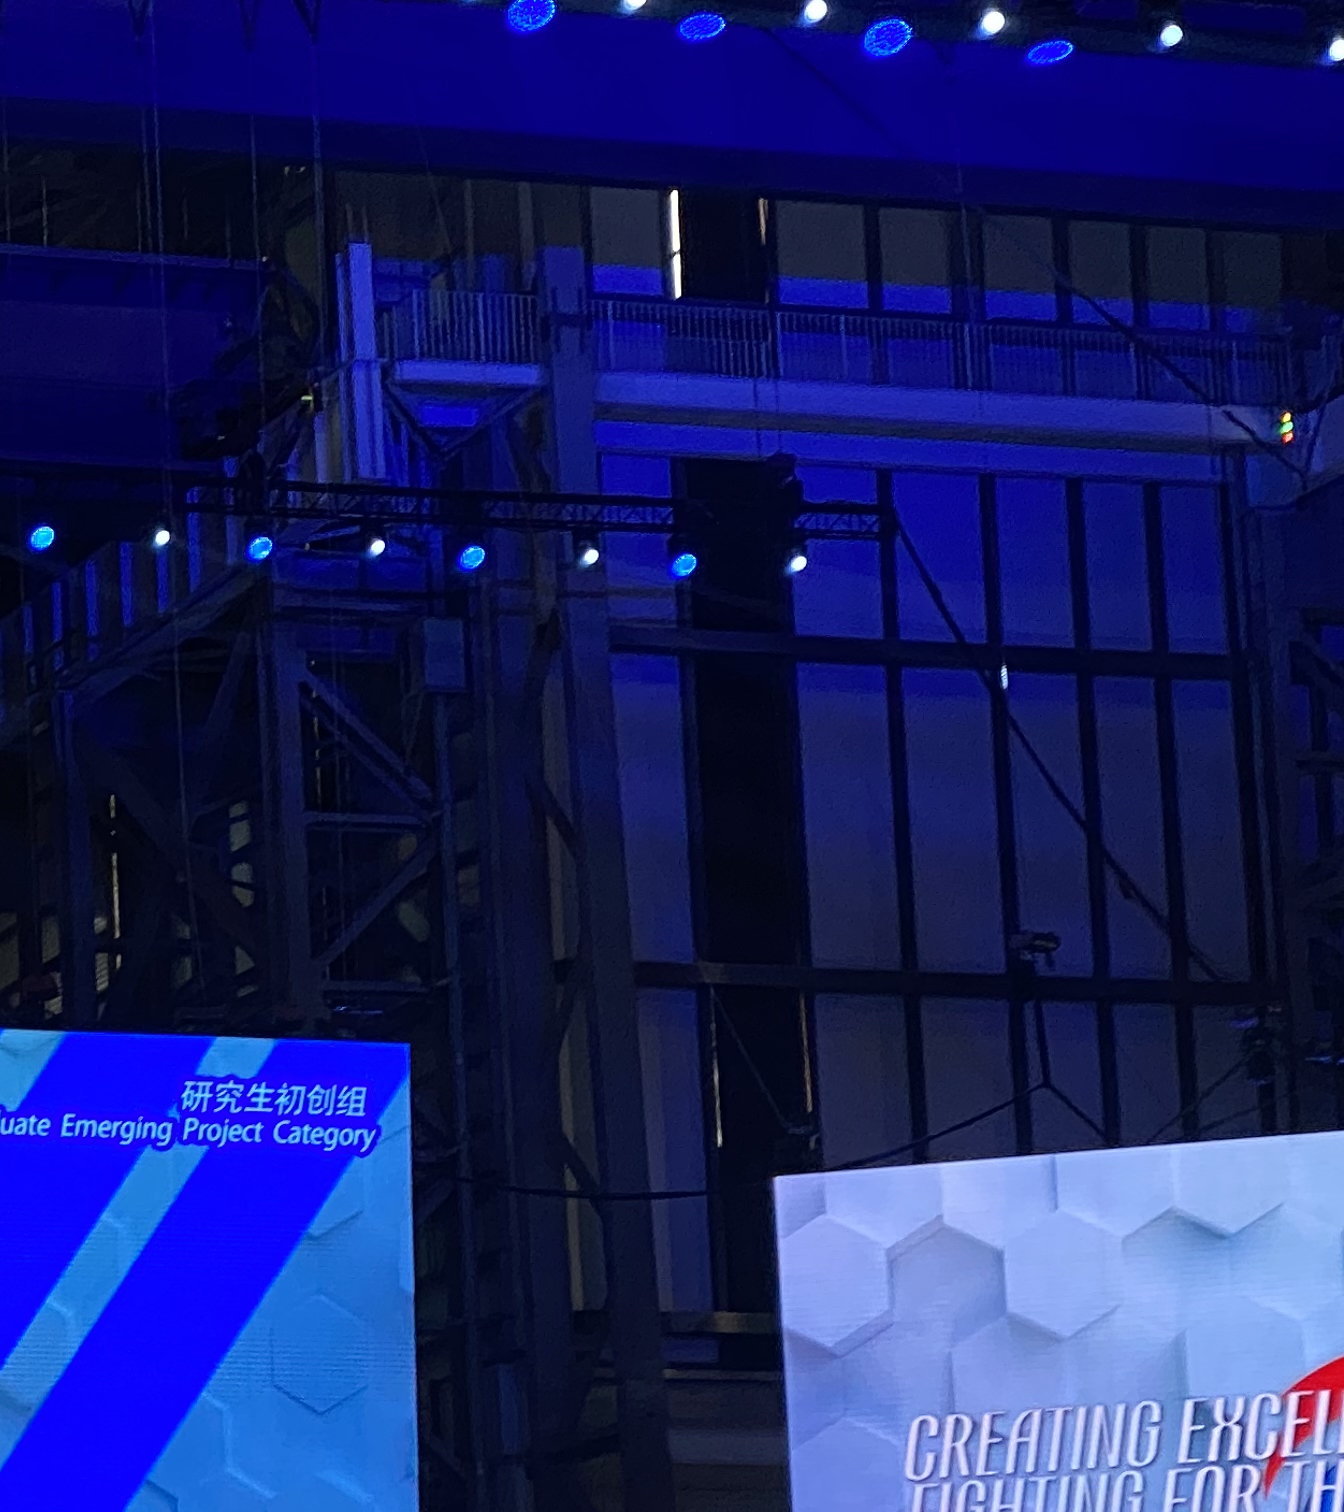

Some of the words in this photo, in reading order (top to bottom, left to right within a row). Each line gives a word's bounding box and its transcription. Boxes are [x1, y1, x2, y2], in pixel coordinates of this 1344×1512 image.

[180, 1080, 368, 1117] 研究生初创组
[60, 1113, 173, 1147] Emerging
[182, 1117, 263, 1149] Project
[273, 1122, 377, 1153] Category
[904, 1400, 1162, 1482] CREATING
[1178, 1389, 1344, 1464] EXCEL
